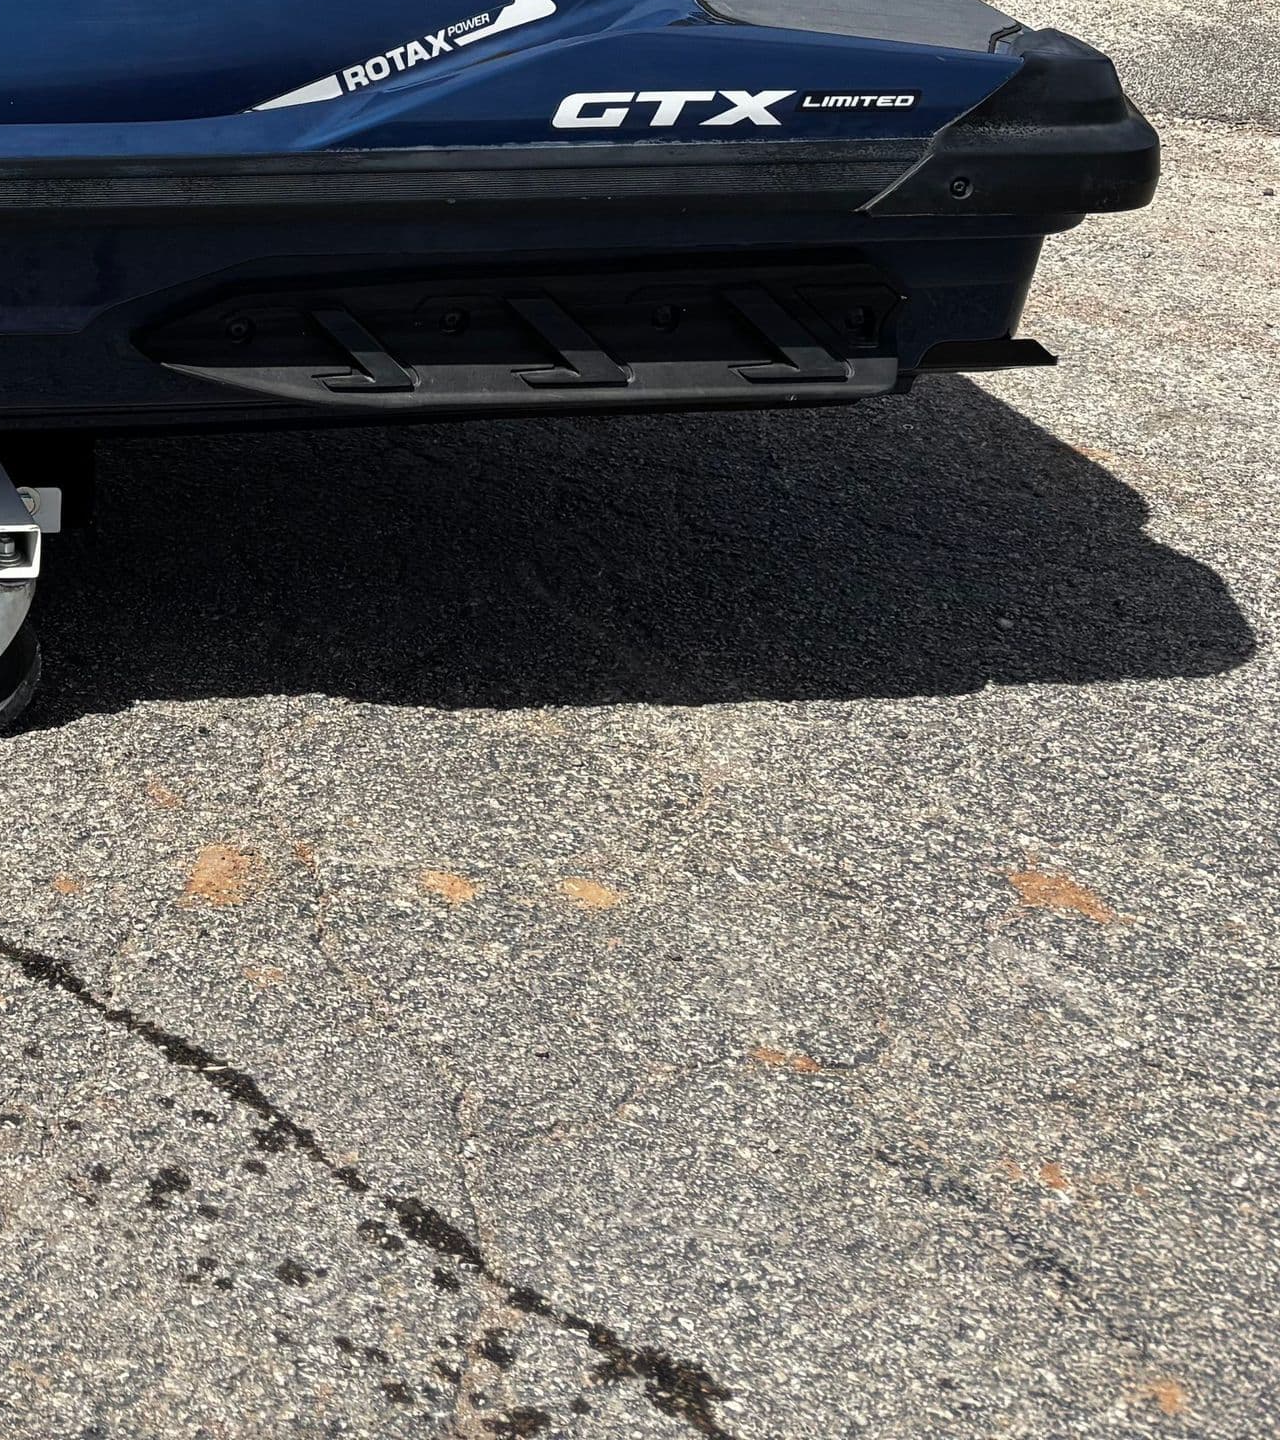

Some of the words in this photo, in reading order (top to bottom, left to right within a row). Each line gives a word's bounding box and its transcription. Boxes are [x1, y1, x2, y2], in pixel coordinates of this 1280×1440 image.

[342, 29, 454, 92] ROTAX
[447, 12, 490, 37] POWER
[552, 90, 798, 129] GTX
[802, 95, 915, 108] LIMITED
